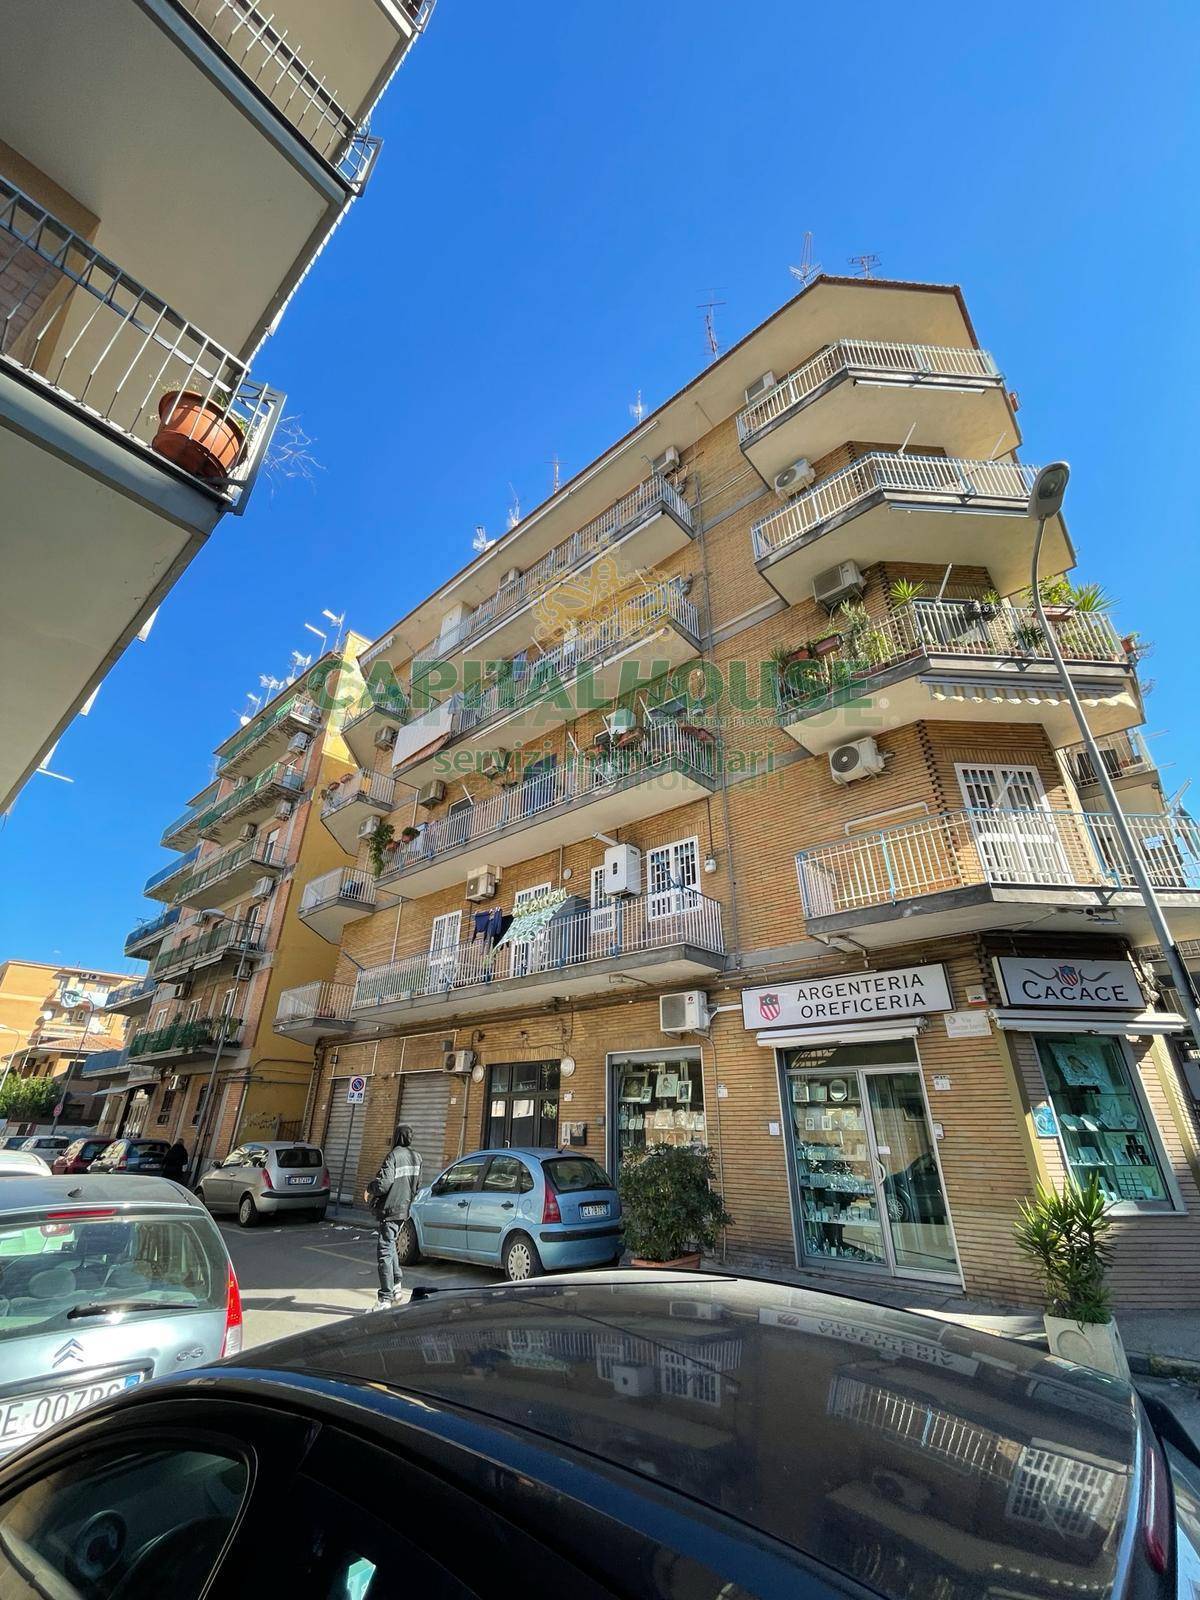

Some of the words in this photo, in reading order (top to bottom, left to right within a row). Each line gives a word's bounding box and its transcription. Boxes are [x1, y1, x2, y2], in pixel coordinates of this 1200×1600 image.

[797, 973, 924, 1002] ARGENTERIA
[1022, 980, 1129, 1002] CACACE
[800, 992, 927, 1019] OREFICERIA
